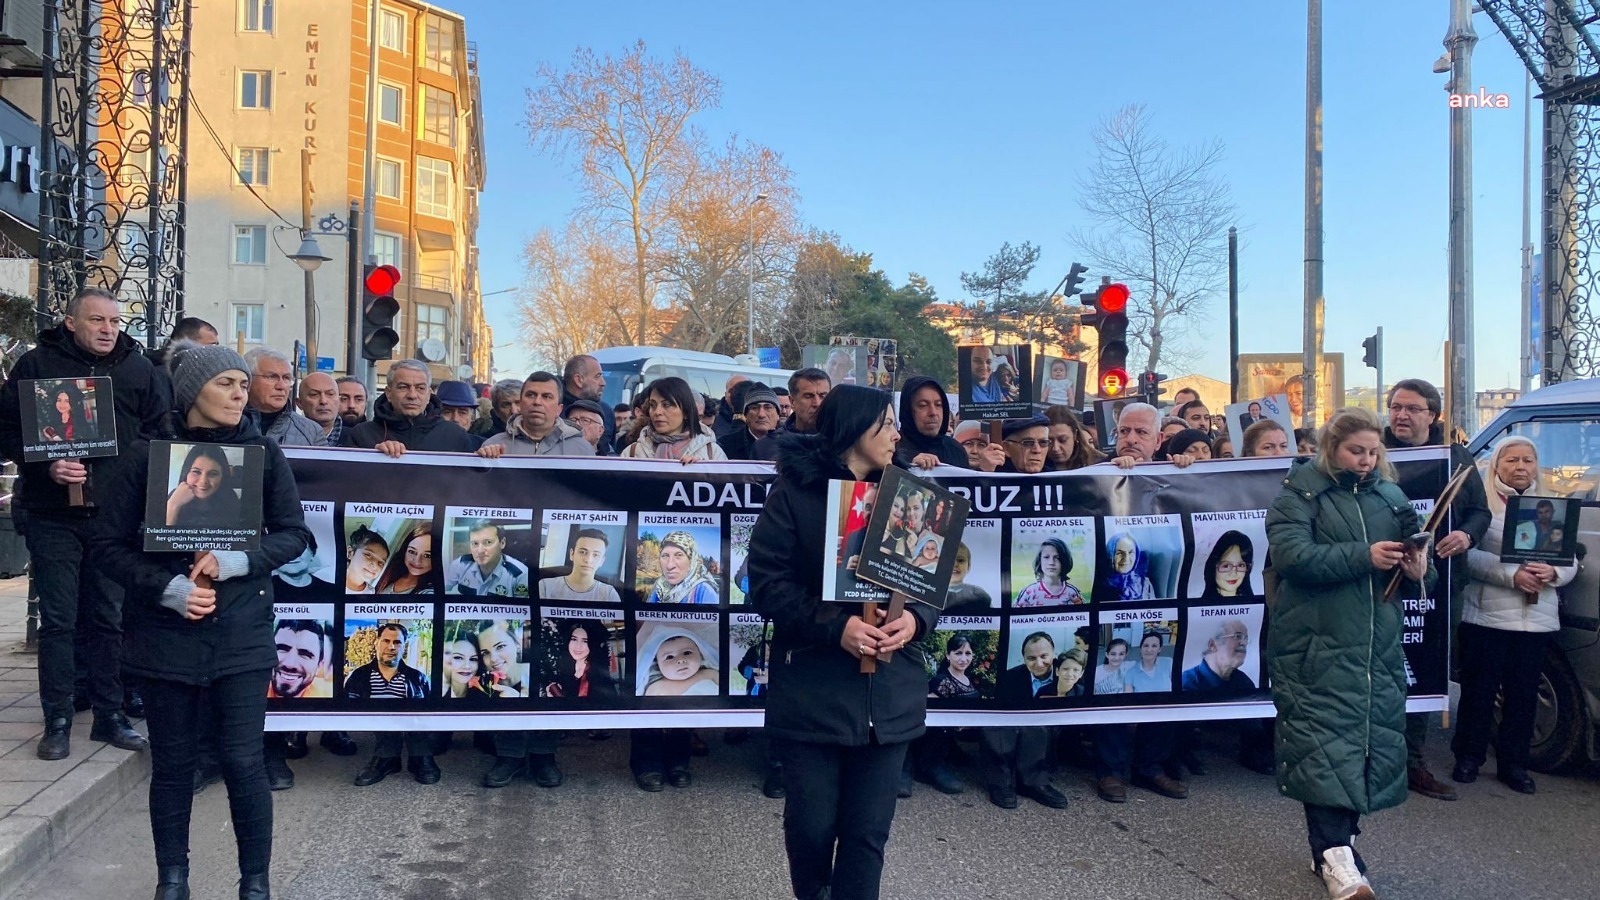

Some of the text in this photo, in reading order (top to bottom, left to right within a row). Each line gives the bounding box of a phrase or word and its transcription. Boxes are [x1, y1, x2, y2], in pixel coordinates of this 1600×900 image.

[68, 449, 89, 457] BİLGİN
[1033, 485, 1064, 511] !!!
[353, 504, 425, 516] YAĞMUR LAÇİN
[462, 508, 517, 518] SEYFİ ERBİL
[551, 512, 619, 522] SERHAT ŞAHİN
[644, 514, 714, 525] RUZİBE KARTAL
[733, 515, 755, 523] ÖZGE
[1115, 516, 1170, 526] MELEK TUNA
[1194, 512, 1236, 522] MAVİNUR
[1020, 519, 1043, 528] OĞUZ
[1045, 519, 1067, 527] ARDA
[172, 542, 231, 550] Derya KURTULUŞ
[354, 604, 425, 614] ERGÜN KERPİÇ
[448, 605, 528, 616] DERYA KURTULUŞ
[1402, 600, 1435, 611] TREN
[550, 608, 616, 618] BİHTER BİLGİN
[639, 611, 718, 621] BEREN KURTULUŞ
[1115, 611, 1163, 621] SENA KÖSE
[1201, 608, 1250, 617] İRFAN KURT
[951, 617, 993, 625] BAŞARAN
[1400, 629, 1424, 643] ERİ
